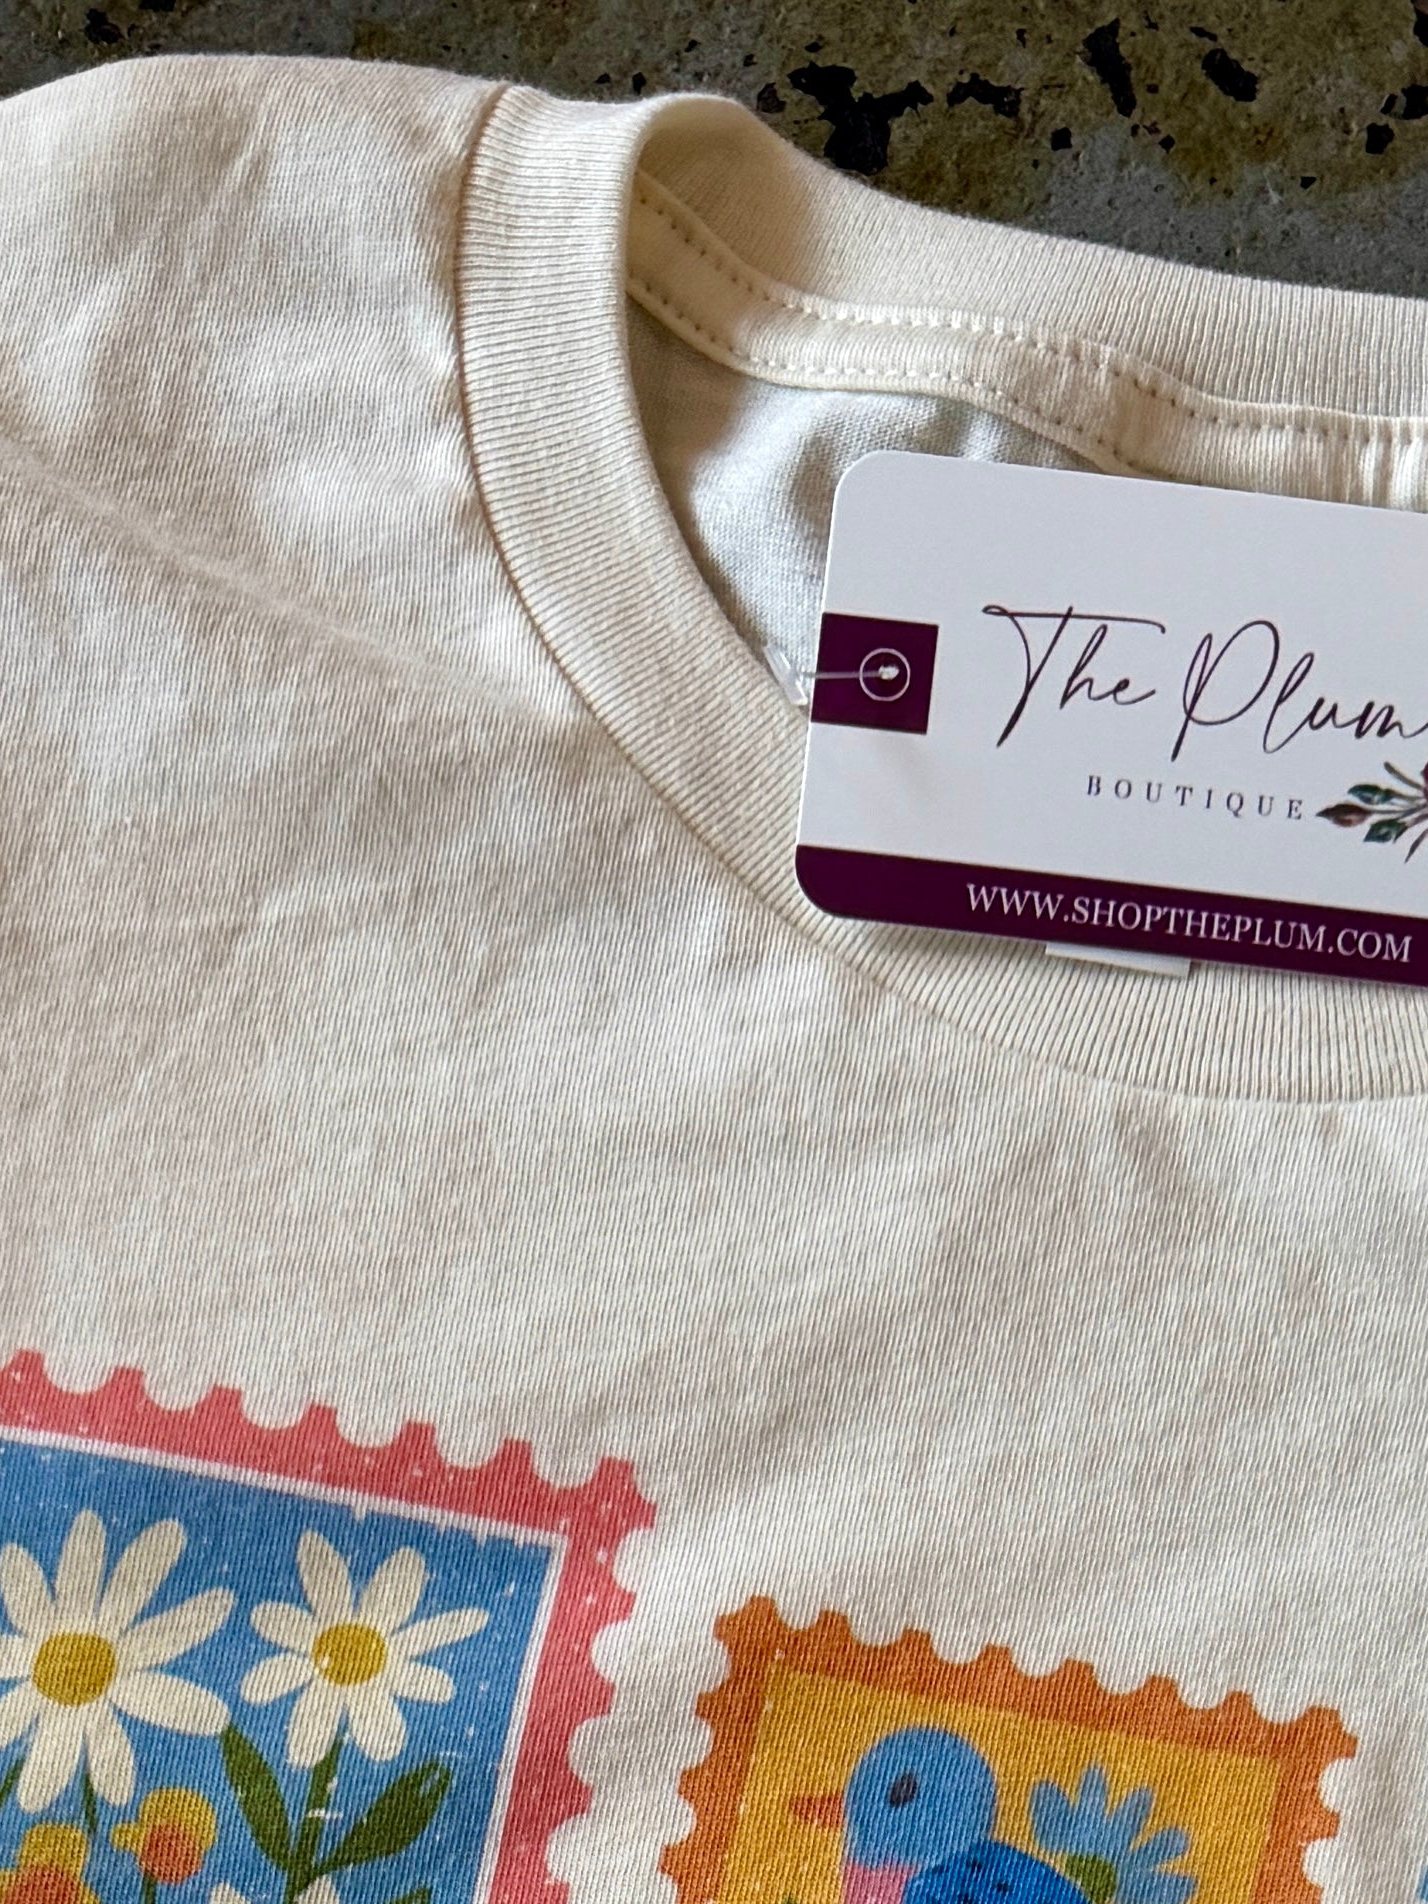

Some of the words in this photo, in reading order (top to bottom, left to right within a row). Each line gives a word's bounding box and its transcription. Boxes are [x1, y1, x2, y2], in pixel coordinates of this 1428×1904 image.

[981, 604, 1167, 748] The
[1085, 774, 1305, 821] BOUTIQUE
[966, 882, 1413, 964] WWW.SHOPTHEPLUM.COM
